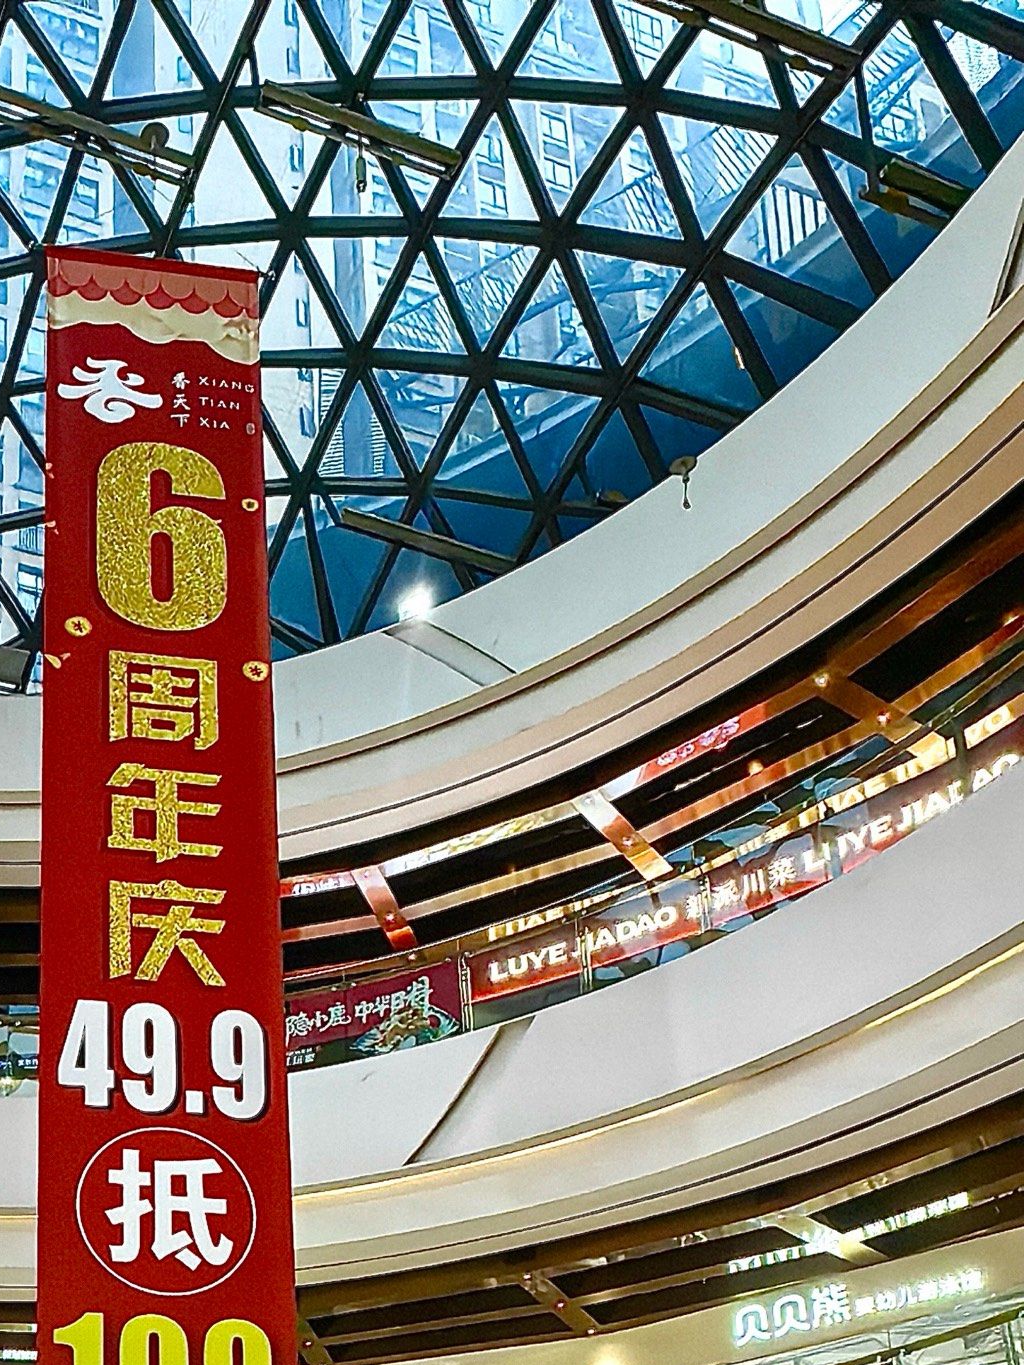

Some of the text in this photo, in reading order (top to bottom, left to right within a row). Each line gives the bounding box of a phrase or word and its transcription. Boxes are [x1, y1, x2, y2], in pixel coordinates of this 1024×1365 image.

[170, 371, 191, 428] 香天下
[198, 375, 255, 394] XIANG
[199, 396, 241, 411] TIAN
[199, 416, 231, 430] XIA
[488, 904, 678, 985] LUYE JIADAO
[57, 999, 266, 1119] 49.9
[105, 1148, 234, 1272] 抵
[734, 1282, 853, 1348] 贝贝熊
